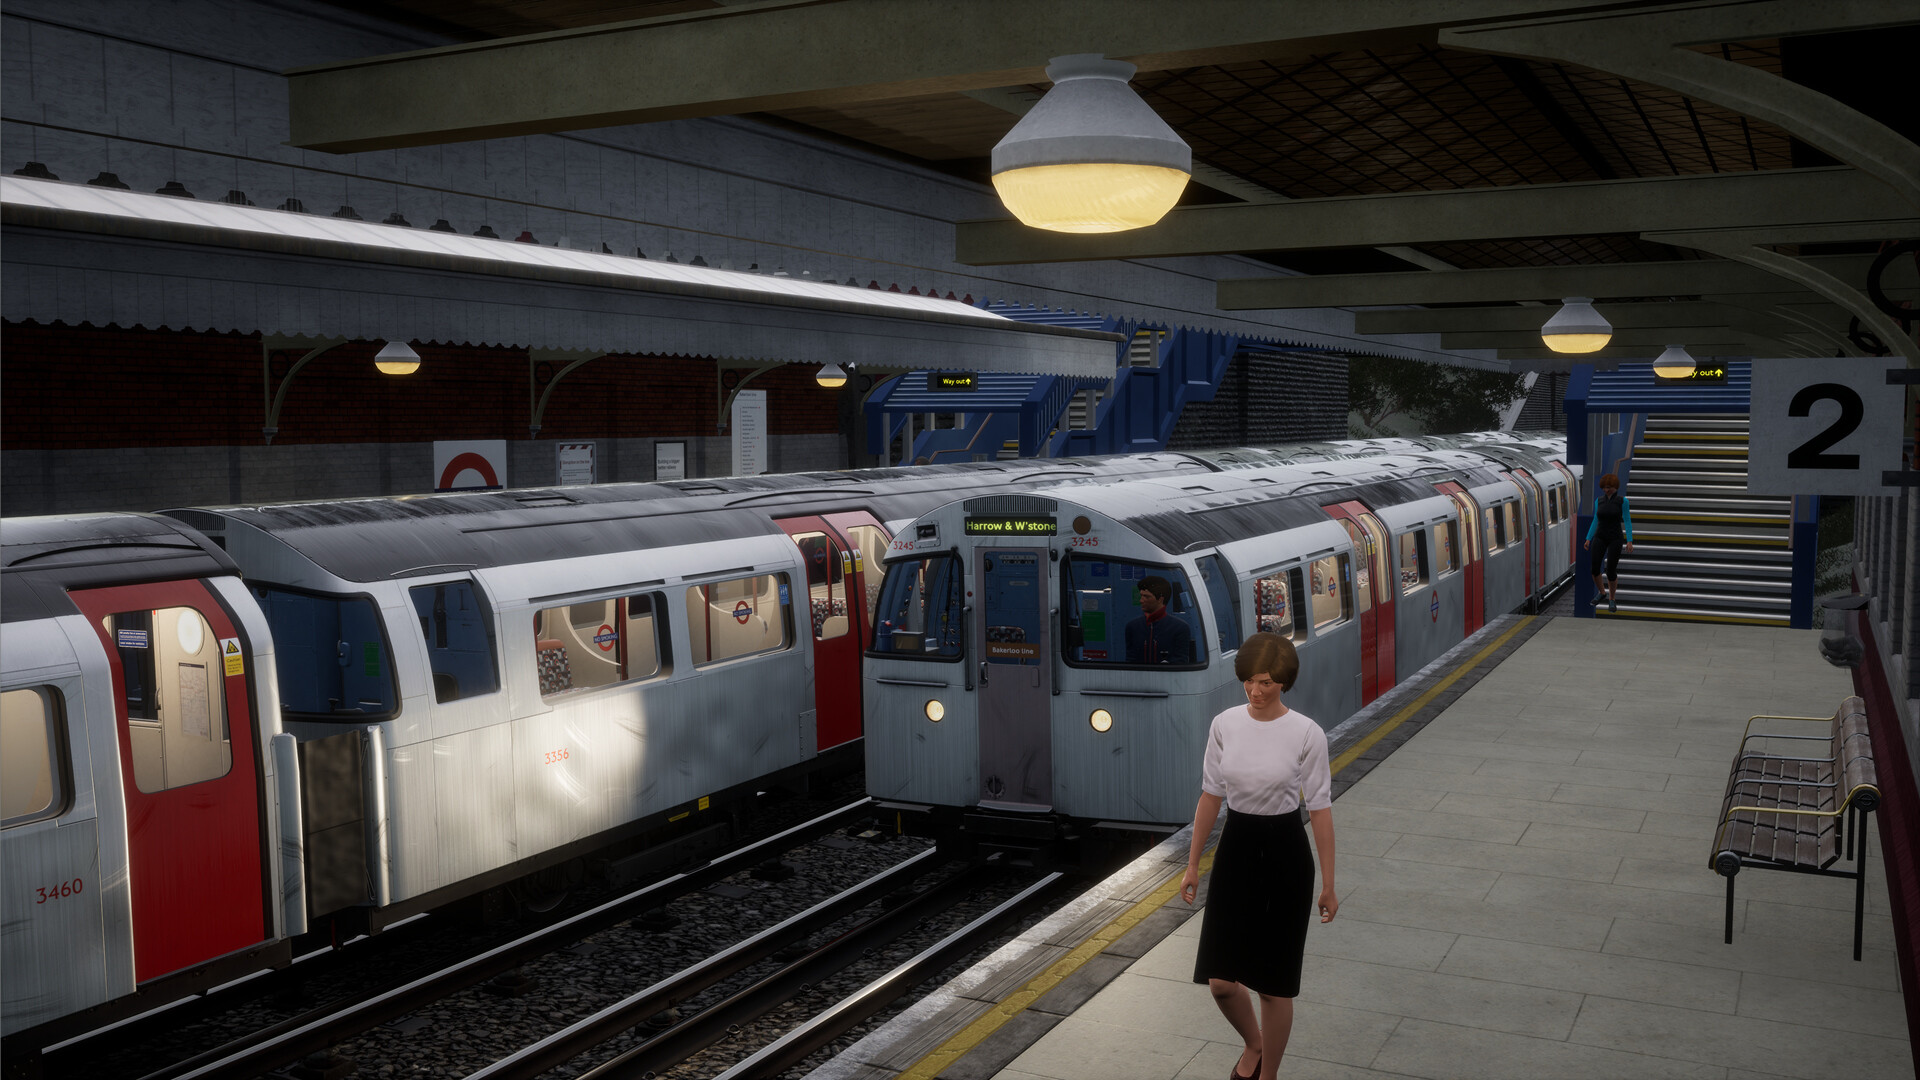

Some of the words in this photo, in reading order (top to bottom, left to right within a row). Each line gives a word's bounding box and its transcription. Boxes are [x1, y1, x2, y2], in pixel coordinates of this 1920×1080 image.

[1787, 382, 1865, 470] 2
[966, 521, 1003, 531] Harrow
[1004, 521, 1013, 531] &
[1014, 521, 1057, 531] W'stone
[893, 540, 914, 550] 3245
[1071, 537, 1099, 547] 3245
[992, 646, 1020, 654] Bakerloo
[544, 747, 569, 765] 3356
[35, 878, 83, 905] 3460
